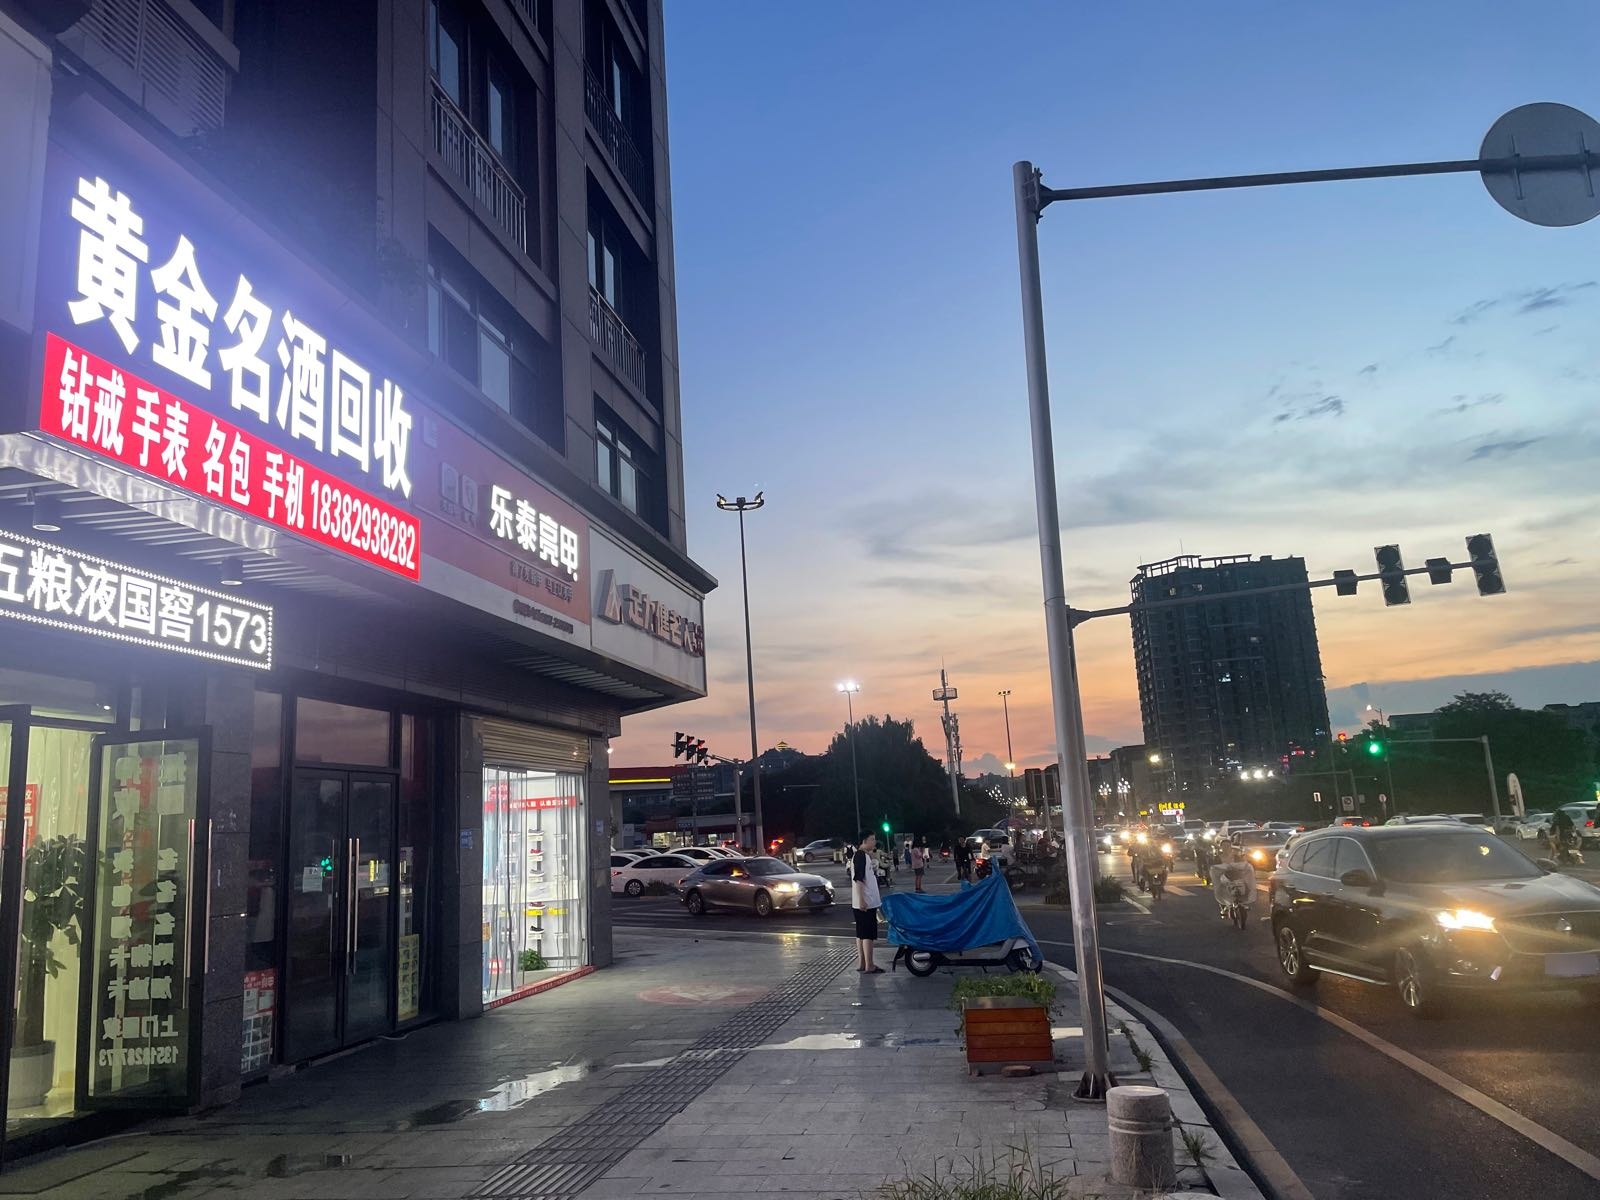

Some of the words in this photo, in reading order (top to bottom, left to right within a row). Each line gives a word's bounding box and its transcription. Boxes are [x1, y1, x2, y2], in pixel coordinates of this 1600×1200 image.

[68, 176, 413, 497] 黄金名酒回收
[59, 347, 126, 456] 钻戒
[131, 387, 190, 481] 手表
[202, 421, 251, 506] 名包
[263, 451, 304, 529] 手机
[310, 480, 416, 570] 18382938282
[490, 484, 579, 580] 乐泰亮甲
